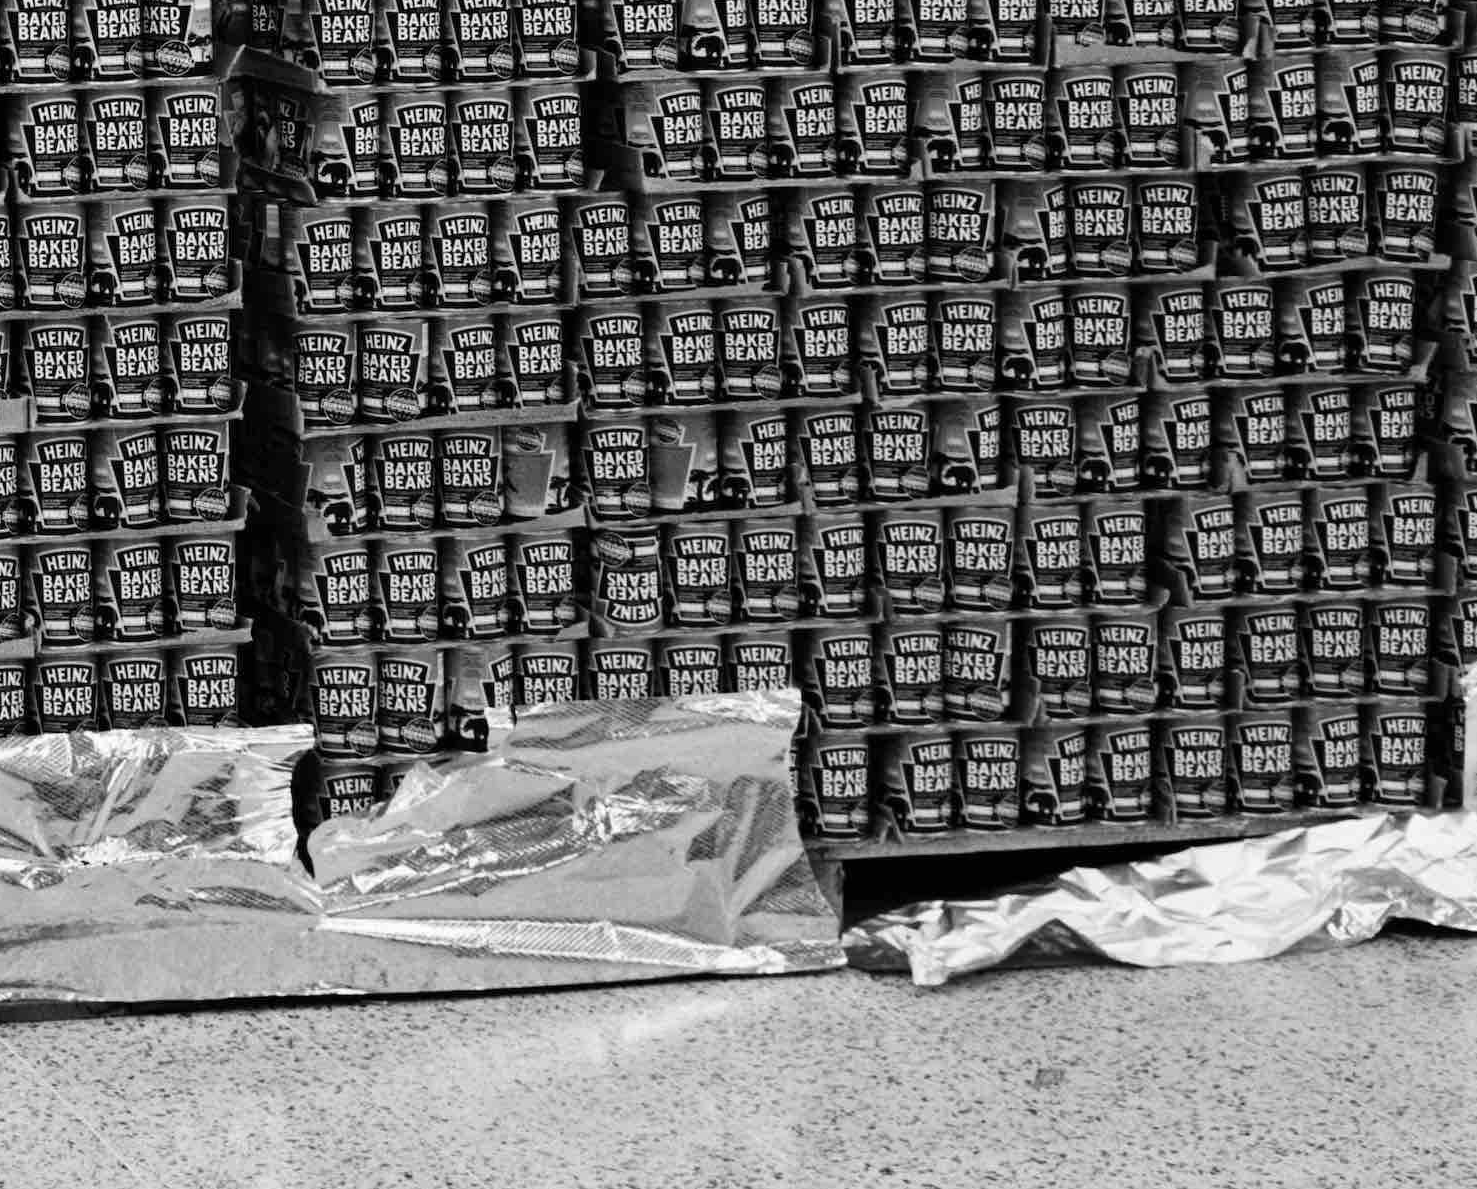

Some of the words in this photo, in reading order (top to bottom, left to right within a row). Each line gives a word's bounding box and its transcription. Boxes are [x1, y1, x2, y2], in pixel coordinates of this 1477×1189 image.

[1050, 4, 1099, 18] BEANS
[461, 11, 509, 27] BAKED
[462, 26, 509, 42] BEANS
[1312, 177, 1354, 194] HEINZ
[1079, 189, 1121, 205] HEINZ
[1310, 195, 1359, 211] BAKED
[1076, 208, 1125, 222] BAKED
[1310, 209, 1360, 225] BEANS
[31, 219, 76, 236] HEINZ
[1076, 222, 1125, 236] BEANS
[28, 239, 79, 254] BAKED
[28, 254, 78, 268] BEANS
[1023, 410, 1067, 427] HEINZ
[170, 435, 213, 451] HEINZ
[1021, 429, 1071, 444] BAKED
[446, 439, 487, 455] HEINZ
[1022, 443, 1071, 457] BEANS
[168, 455, 218, 469] BAKED
[444, 459, 491, 473] BAKED
[168, 469, 219, 483] BEANS
[444, 473, 492, 487] BEANS
[116, 663, 159, 680] HEINZ
[113, 683, 162, 698] BAKED
[113, 698, 160, 712] BEANS
